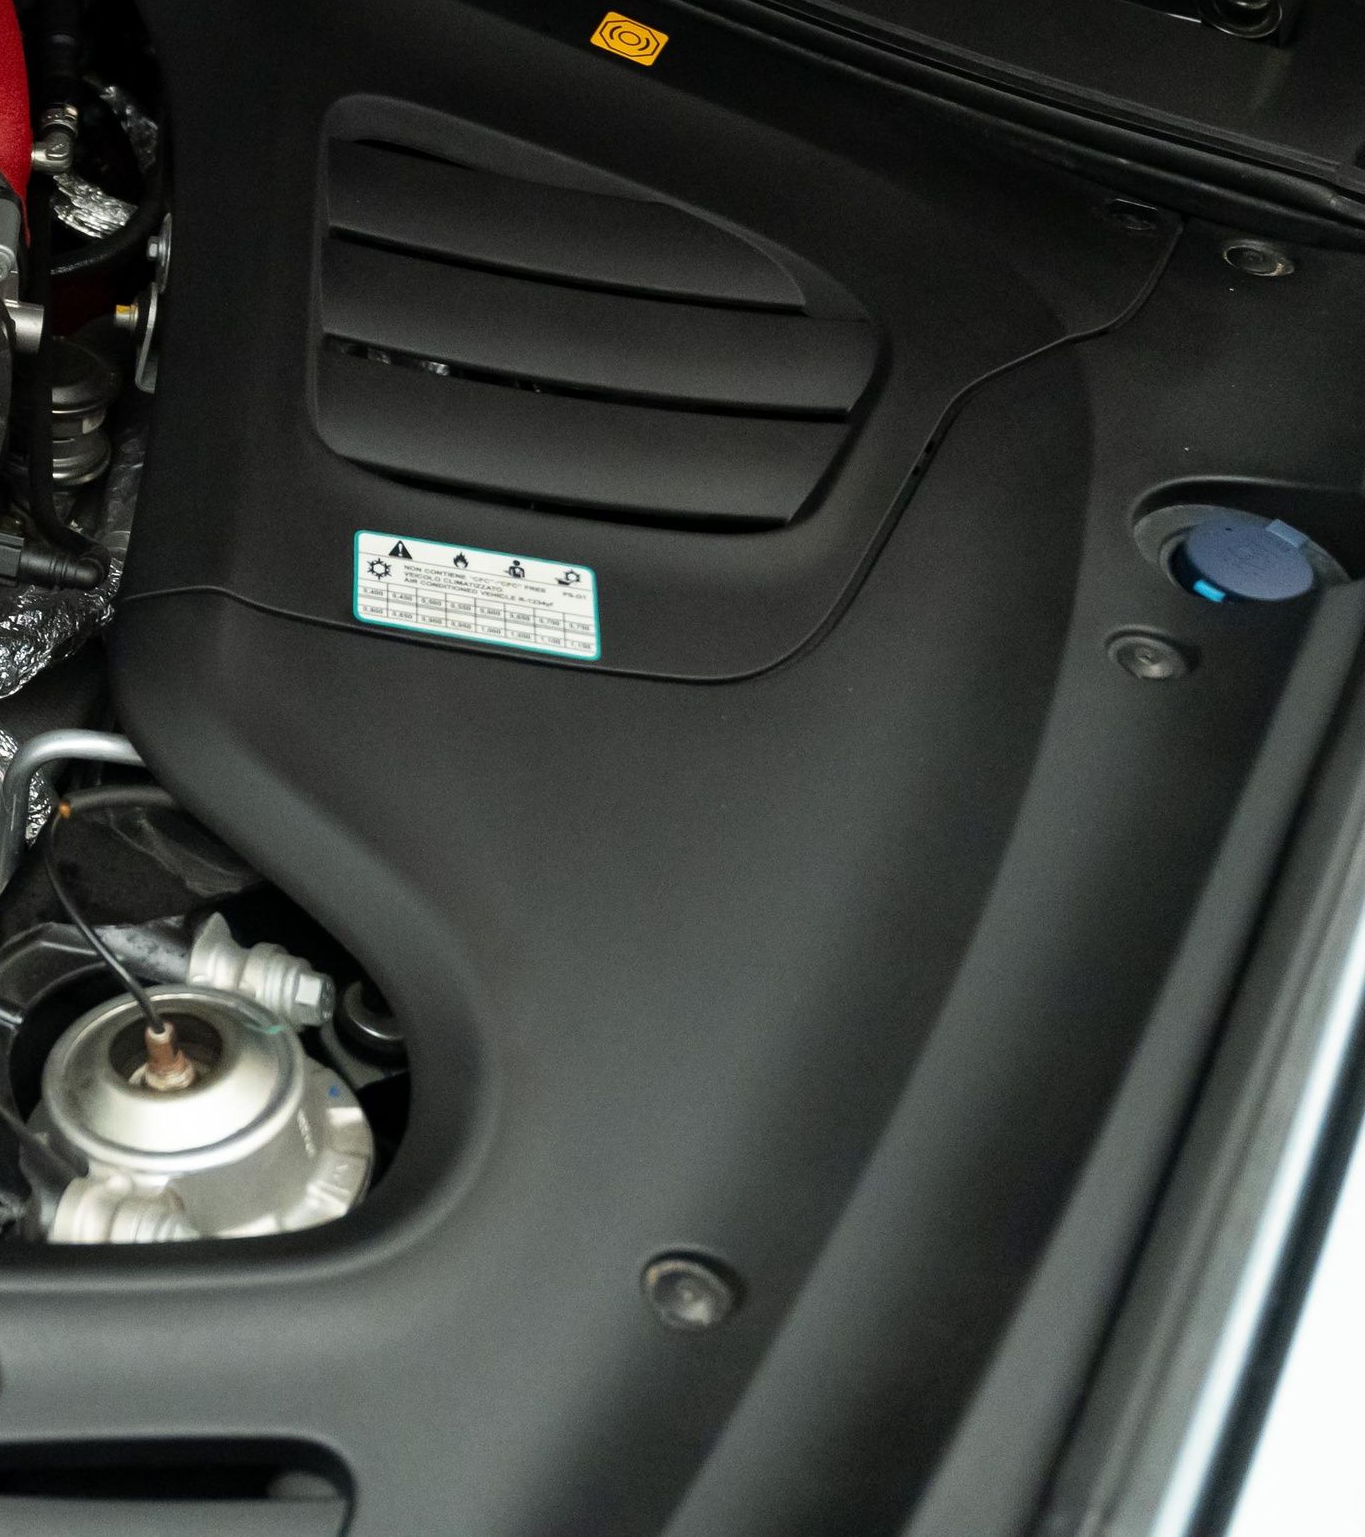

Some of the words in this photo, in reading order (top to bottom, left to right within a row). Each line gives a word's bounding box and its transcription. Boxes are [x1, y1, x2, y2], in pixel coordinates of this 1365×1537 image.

[404, 564, 421, 572] NON
[404, 572, 441, 582] VEICOLO
[420, 581, 478, 594] CONDITIONED
[480, 591, 515, 601] VEHICLE
